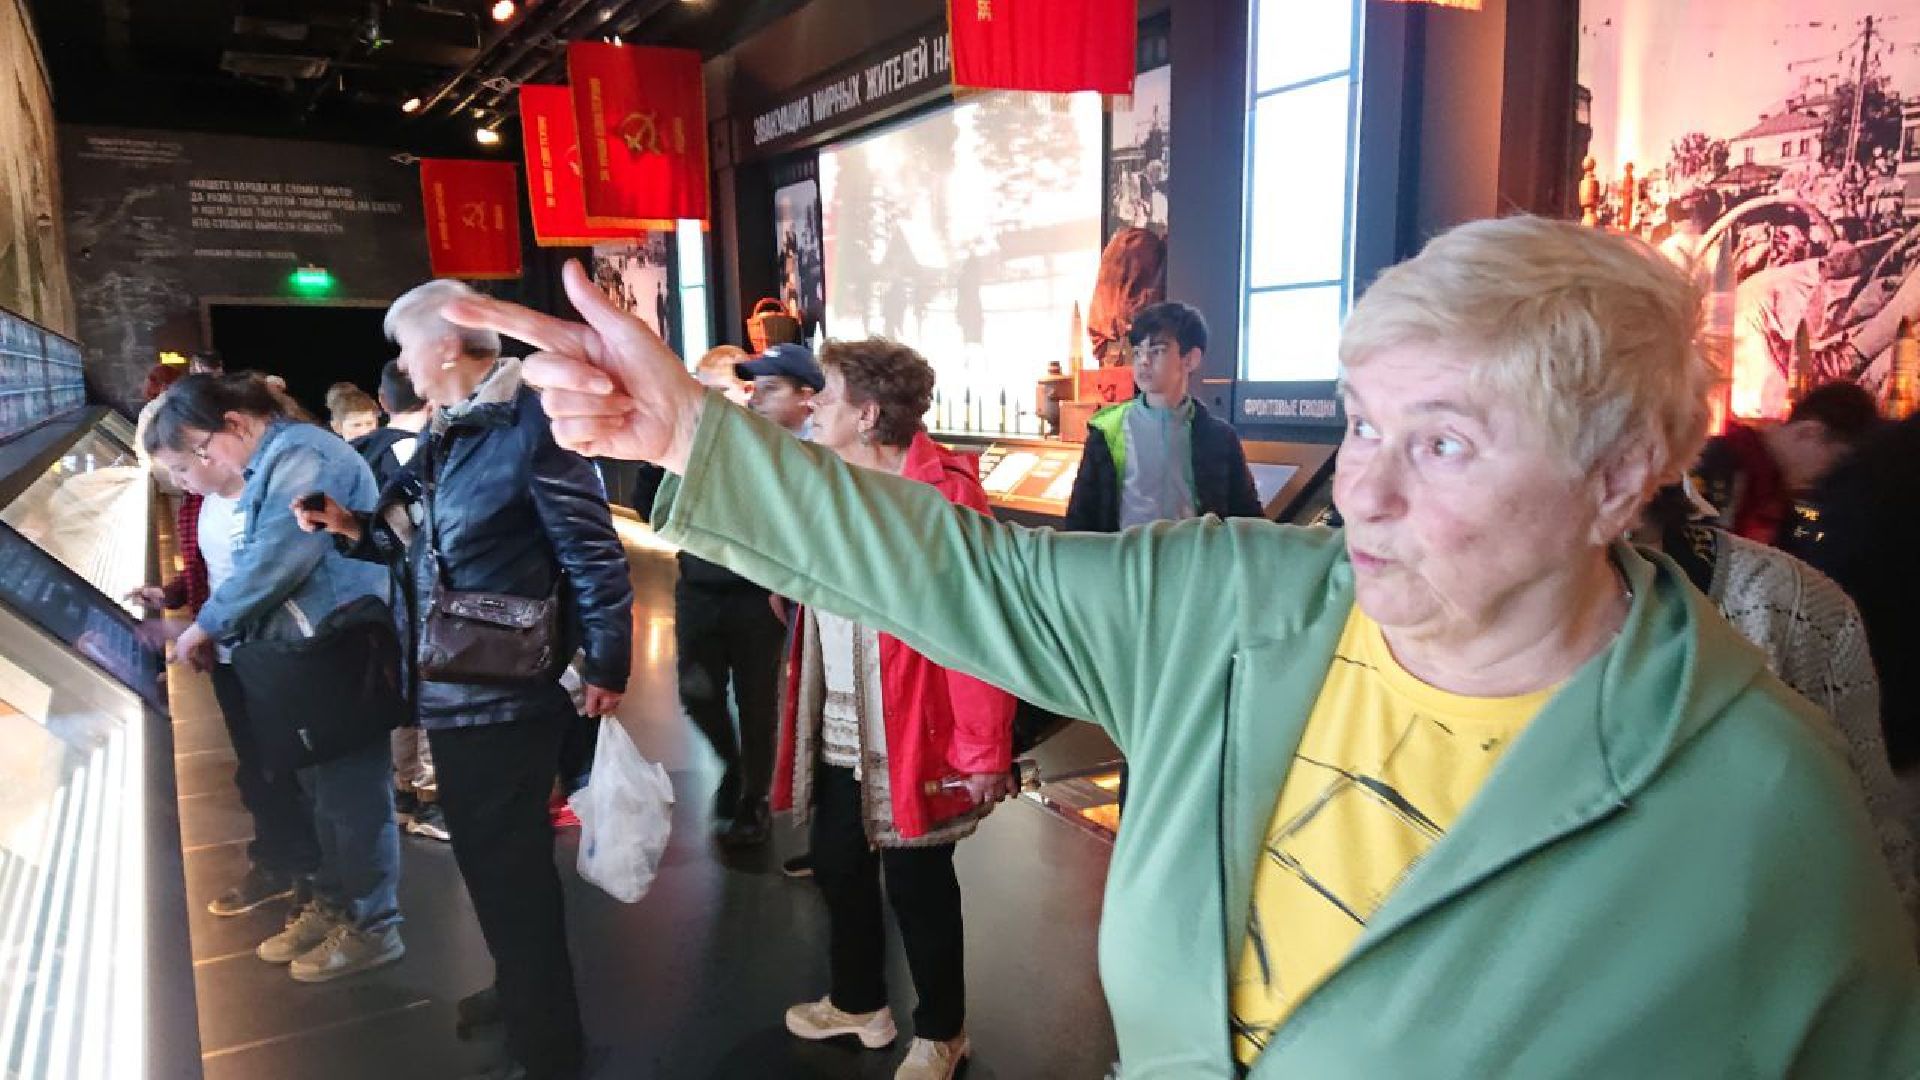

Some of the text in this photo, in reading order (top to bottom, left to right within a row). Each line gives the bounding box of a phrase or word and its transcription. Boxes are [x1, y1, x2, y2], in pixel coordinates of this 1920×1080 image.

[753, 96, 811, 146] ЭВАКУАЦИЯ
[812, 73, 861, 122] МИРНЫХ
[865, 36, 929, 101] ЖИТЕЛЕЙ
